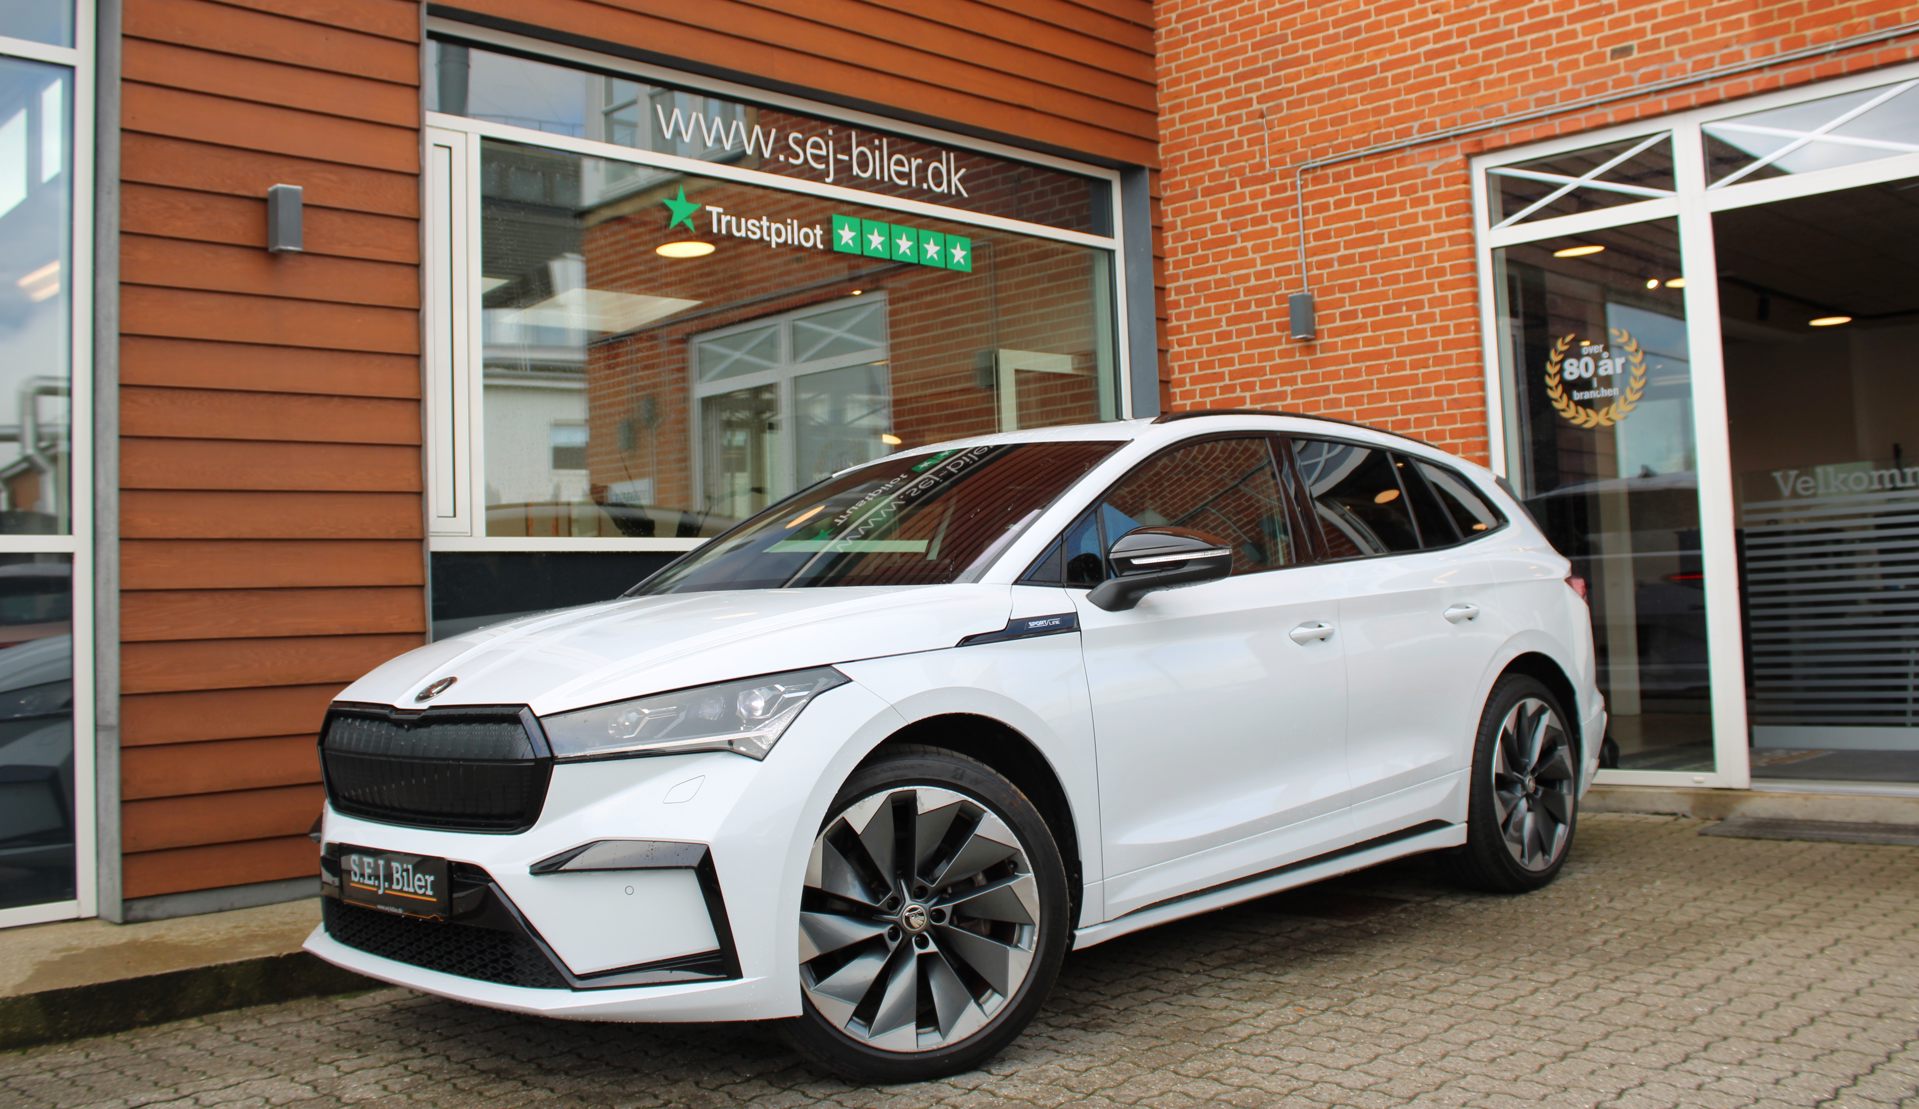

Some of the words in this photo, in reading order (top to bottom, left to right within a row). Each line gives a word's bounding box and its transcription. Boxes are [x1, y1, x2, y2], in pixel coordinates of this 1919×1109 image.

[656, 104, 968, 198] www.sej-biler.dk
[705, 204, 824, 250] Trustpilot
[1562, 356, 1595, 381] 80
[1597, 351, 1626, 376] år
[1582, 343, 1604, 356] over
[1572, 386, 1620, 401] branchen
[350, 854, 389, 895] S.E.J.
[391, 861, 436, 896] Biler
